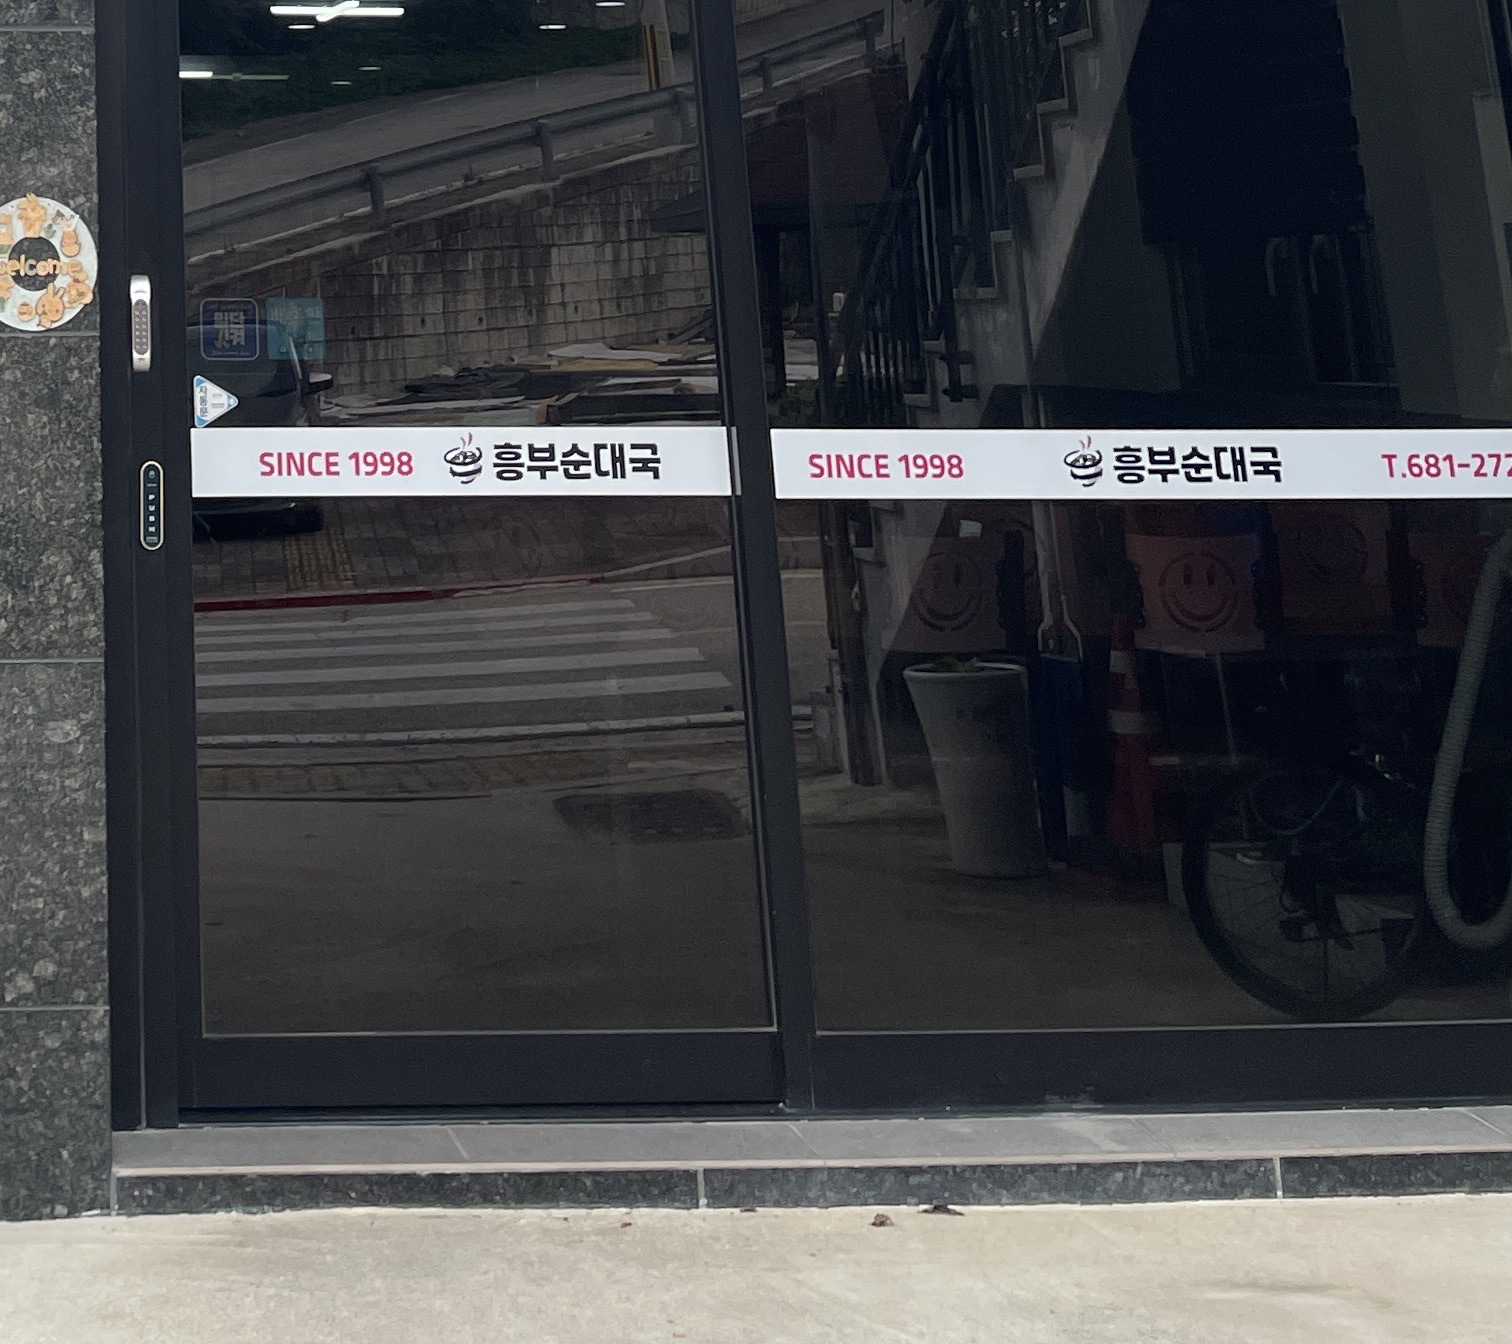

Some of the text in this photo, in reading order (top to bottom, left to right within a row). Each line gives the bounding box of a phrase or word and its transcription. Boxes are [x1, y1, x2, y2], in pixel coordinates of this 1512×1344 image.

[259, 442, 661, 481] SINCE 1998 흥부순대국
[808, 453, 889, 480] SINCE
[897, 454, 964, 480] 1998
[1113, 445, 1282, 484] 흥부순대국
